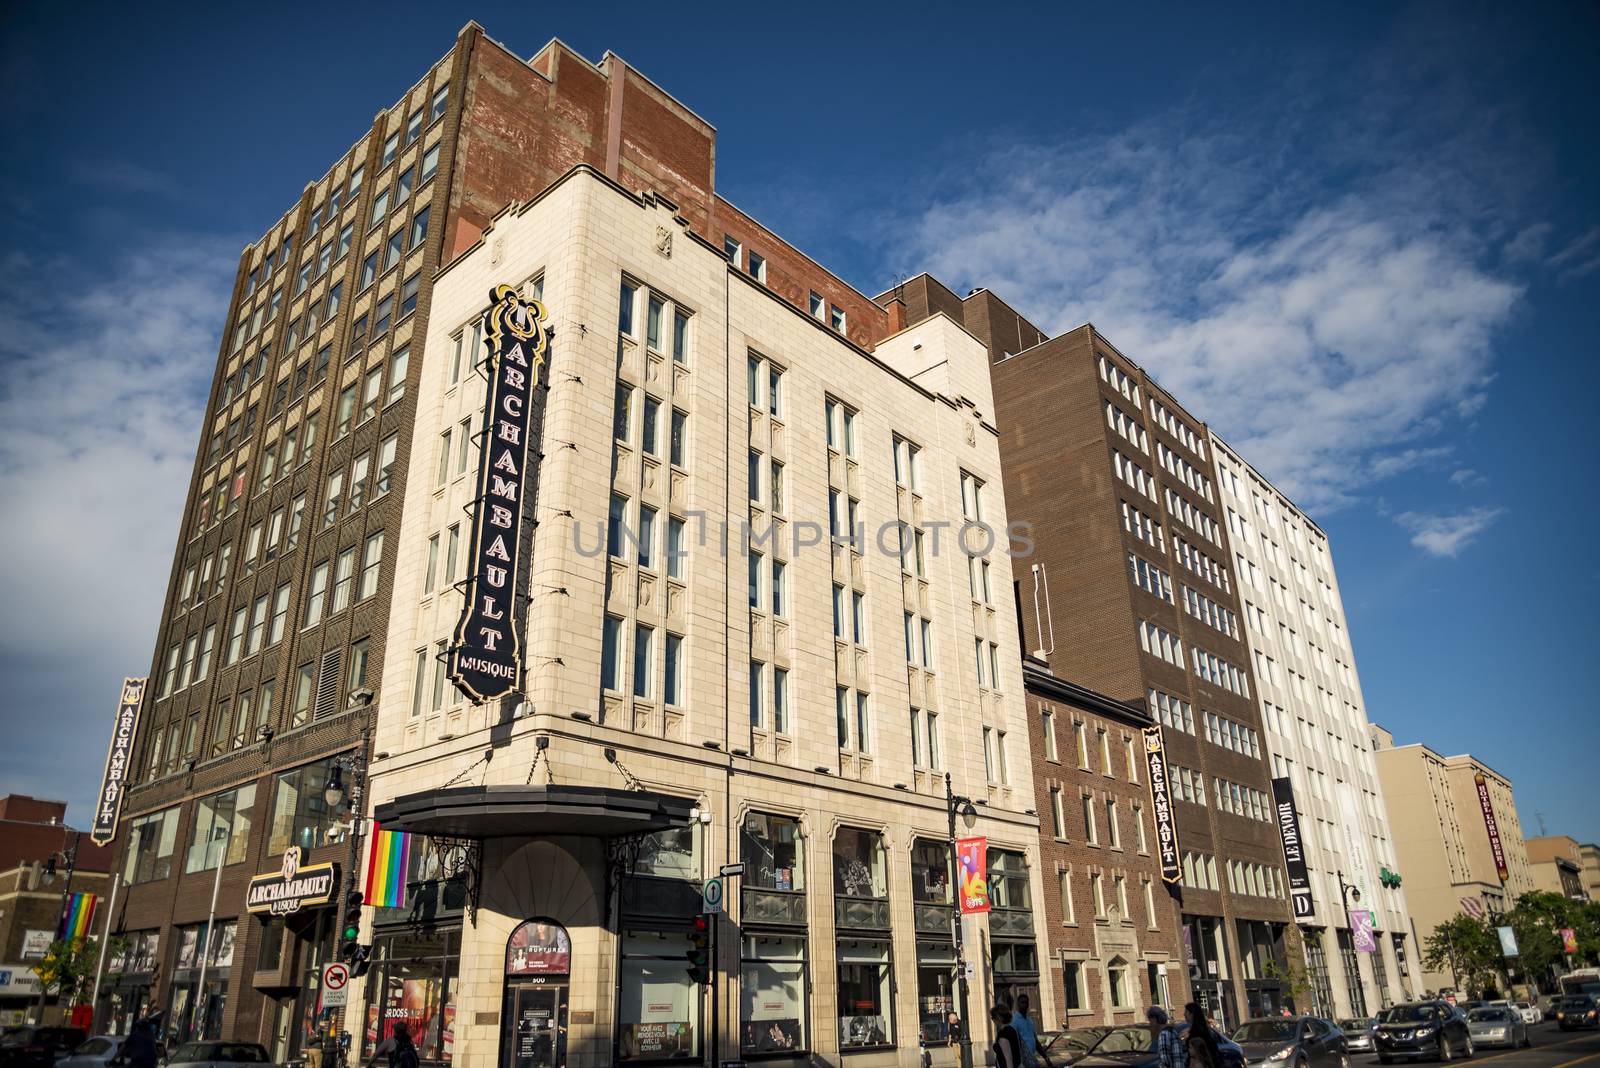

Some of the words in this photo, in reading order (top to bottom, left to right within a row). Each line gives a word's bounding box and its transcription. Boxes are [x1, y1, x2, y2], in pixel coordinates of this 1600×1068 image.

[480, 341, 528, 651] ARCHAMBAULT
[461, 656, 515, 679] MUSIQUE
[100, 706, 135, 824] ARCHAMBAULT
[1150, 753, 1174, 862] ARCHAMBAULT
[1279, 802, 1298, 844] DEVOIR
[1486, 814, 1497, 836] LORD
[1286, 846, 1301, 862] LE
[249, 875, 329, 904] ARCHAMBAULT
[272, 899, 299, 912] MUSIQUE
[1296, 896, 1309, 914] D
